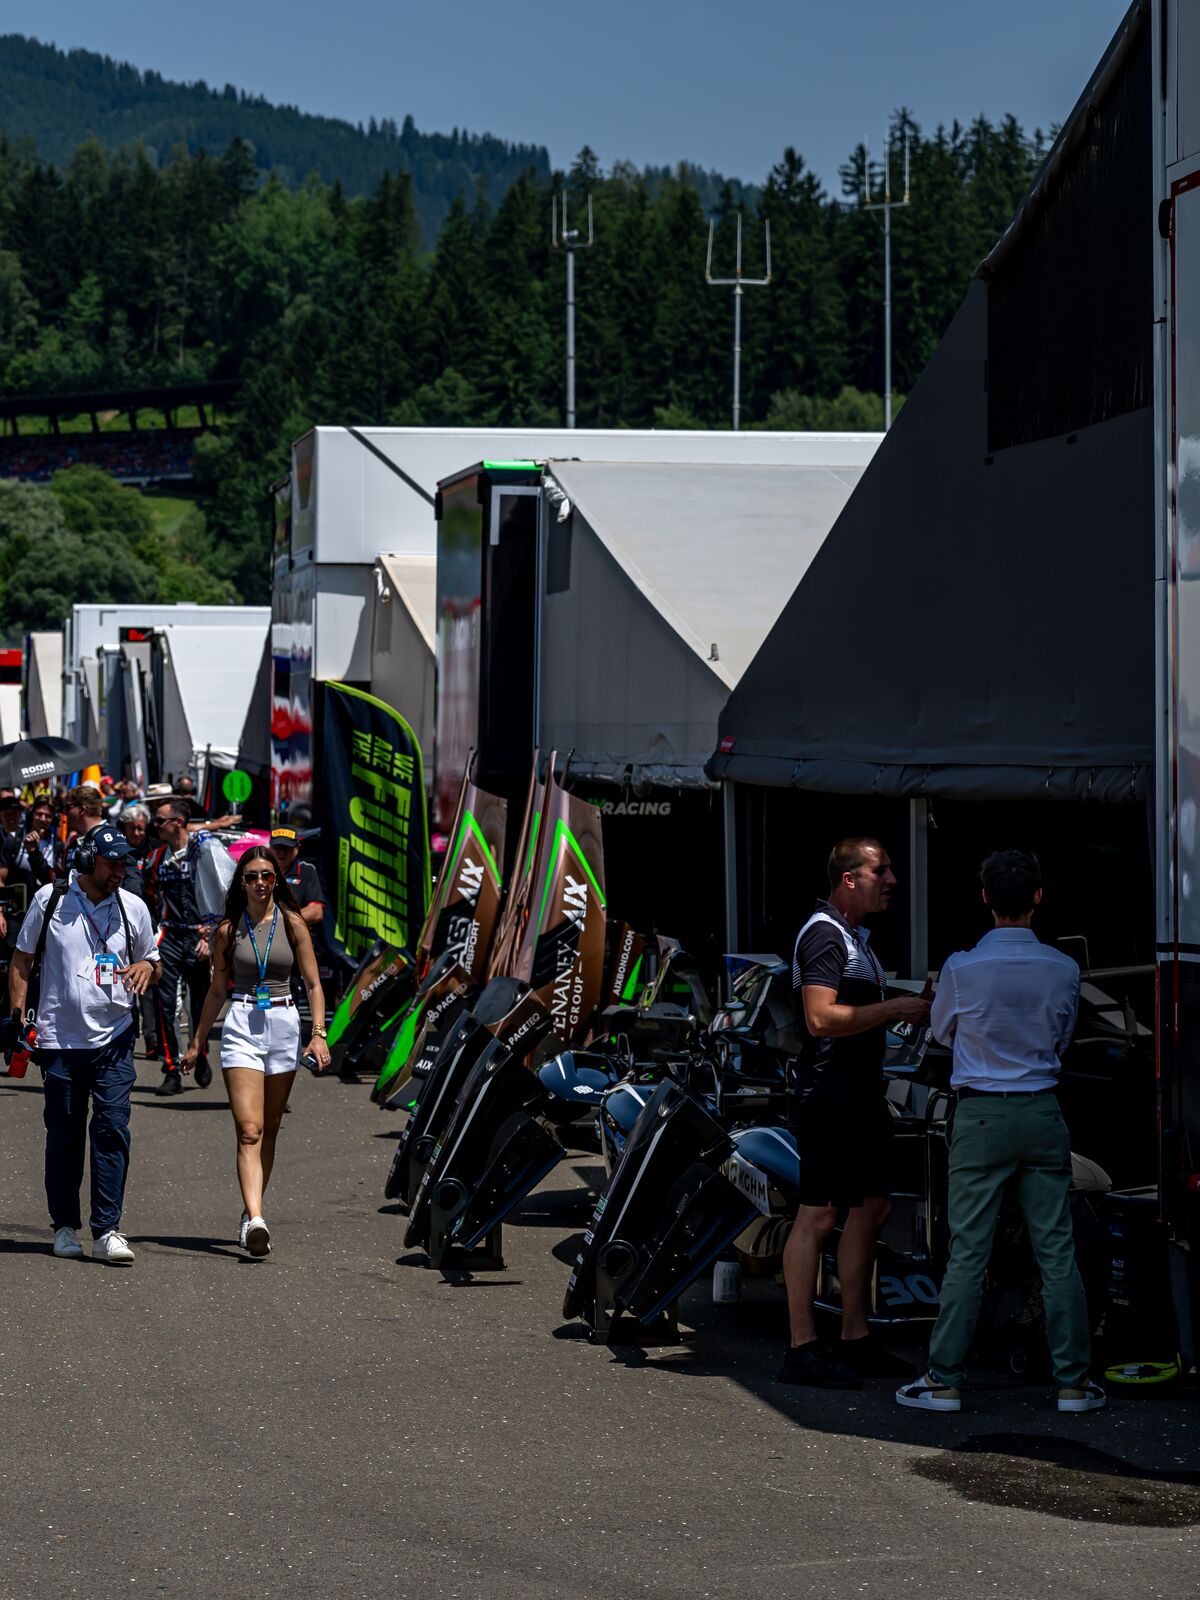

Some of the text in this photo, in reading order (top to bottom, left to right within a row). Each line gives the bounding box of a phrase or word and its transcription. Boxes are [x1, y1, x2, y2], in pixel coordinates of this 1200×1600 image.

[353, 728, 372, 765] THE
[373, 735, 393, 774] ARE
[21, 761, 54, 776] RODIN
[393, 751, 414, 784] WE
[603, 802, 672, 816] RACING
[103, 832, 114, 842] 8
[457, 858, 485, 907] AIX
[562, 874, 589, 932] AIX
[612, 930, 636, 997] AIXBOND.COM
[570, 976, 584, 1025] GROUP
[508, 1012, 541, 1047] PACETEQ
[415, 1059, 434, 1072] AIX
[738, 1167, 767, 1202] KGHM
[880, 1273, 940, 1307] 30
